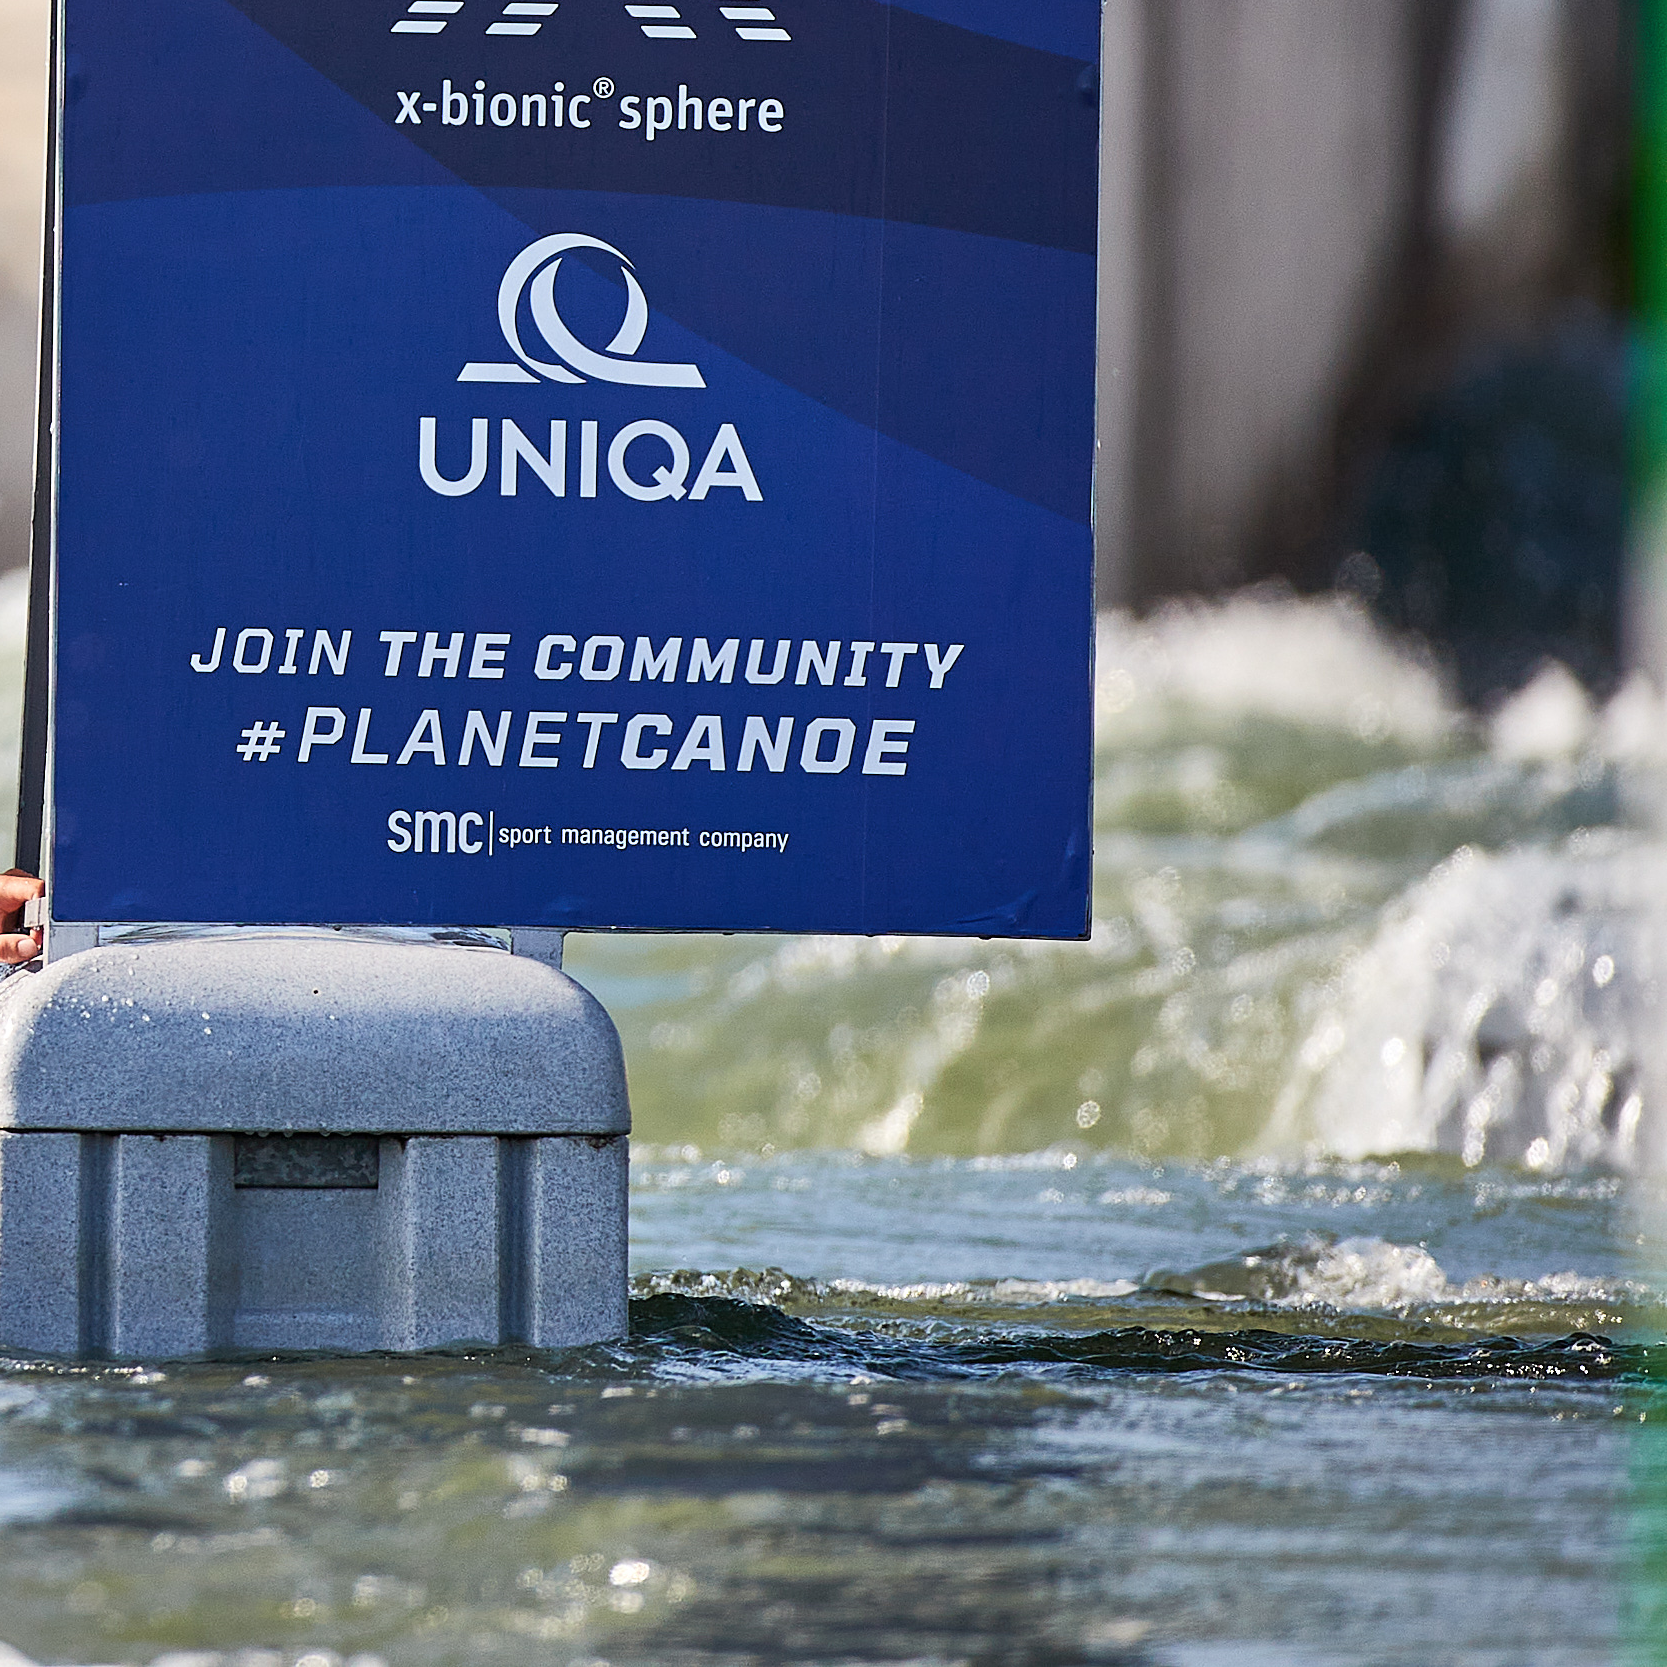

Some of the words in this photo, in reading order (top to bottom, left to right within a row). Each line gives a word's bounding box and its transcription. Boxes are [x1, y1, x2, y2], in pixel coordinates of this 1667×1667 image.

[618, 84, 784, 141] sphere
[419, 416, 764, 502] UNIQA
[190, 627, 352, 676] JOIN
[379, 630, 511, 679] THE
[533, 634, 965, 689] COMMUNITY
[236, 706, 916, 776] #PLANETCANOE
[498, 825, 552, 849] sport
[561, 827, 690, 850] management
[699, 831, 789, 853] company
